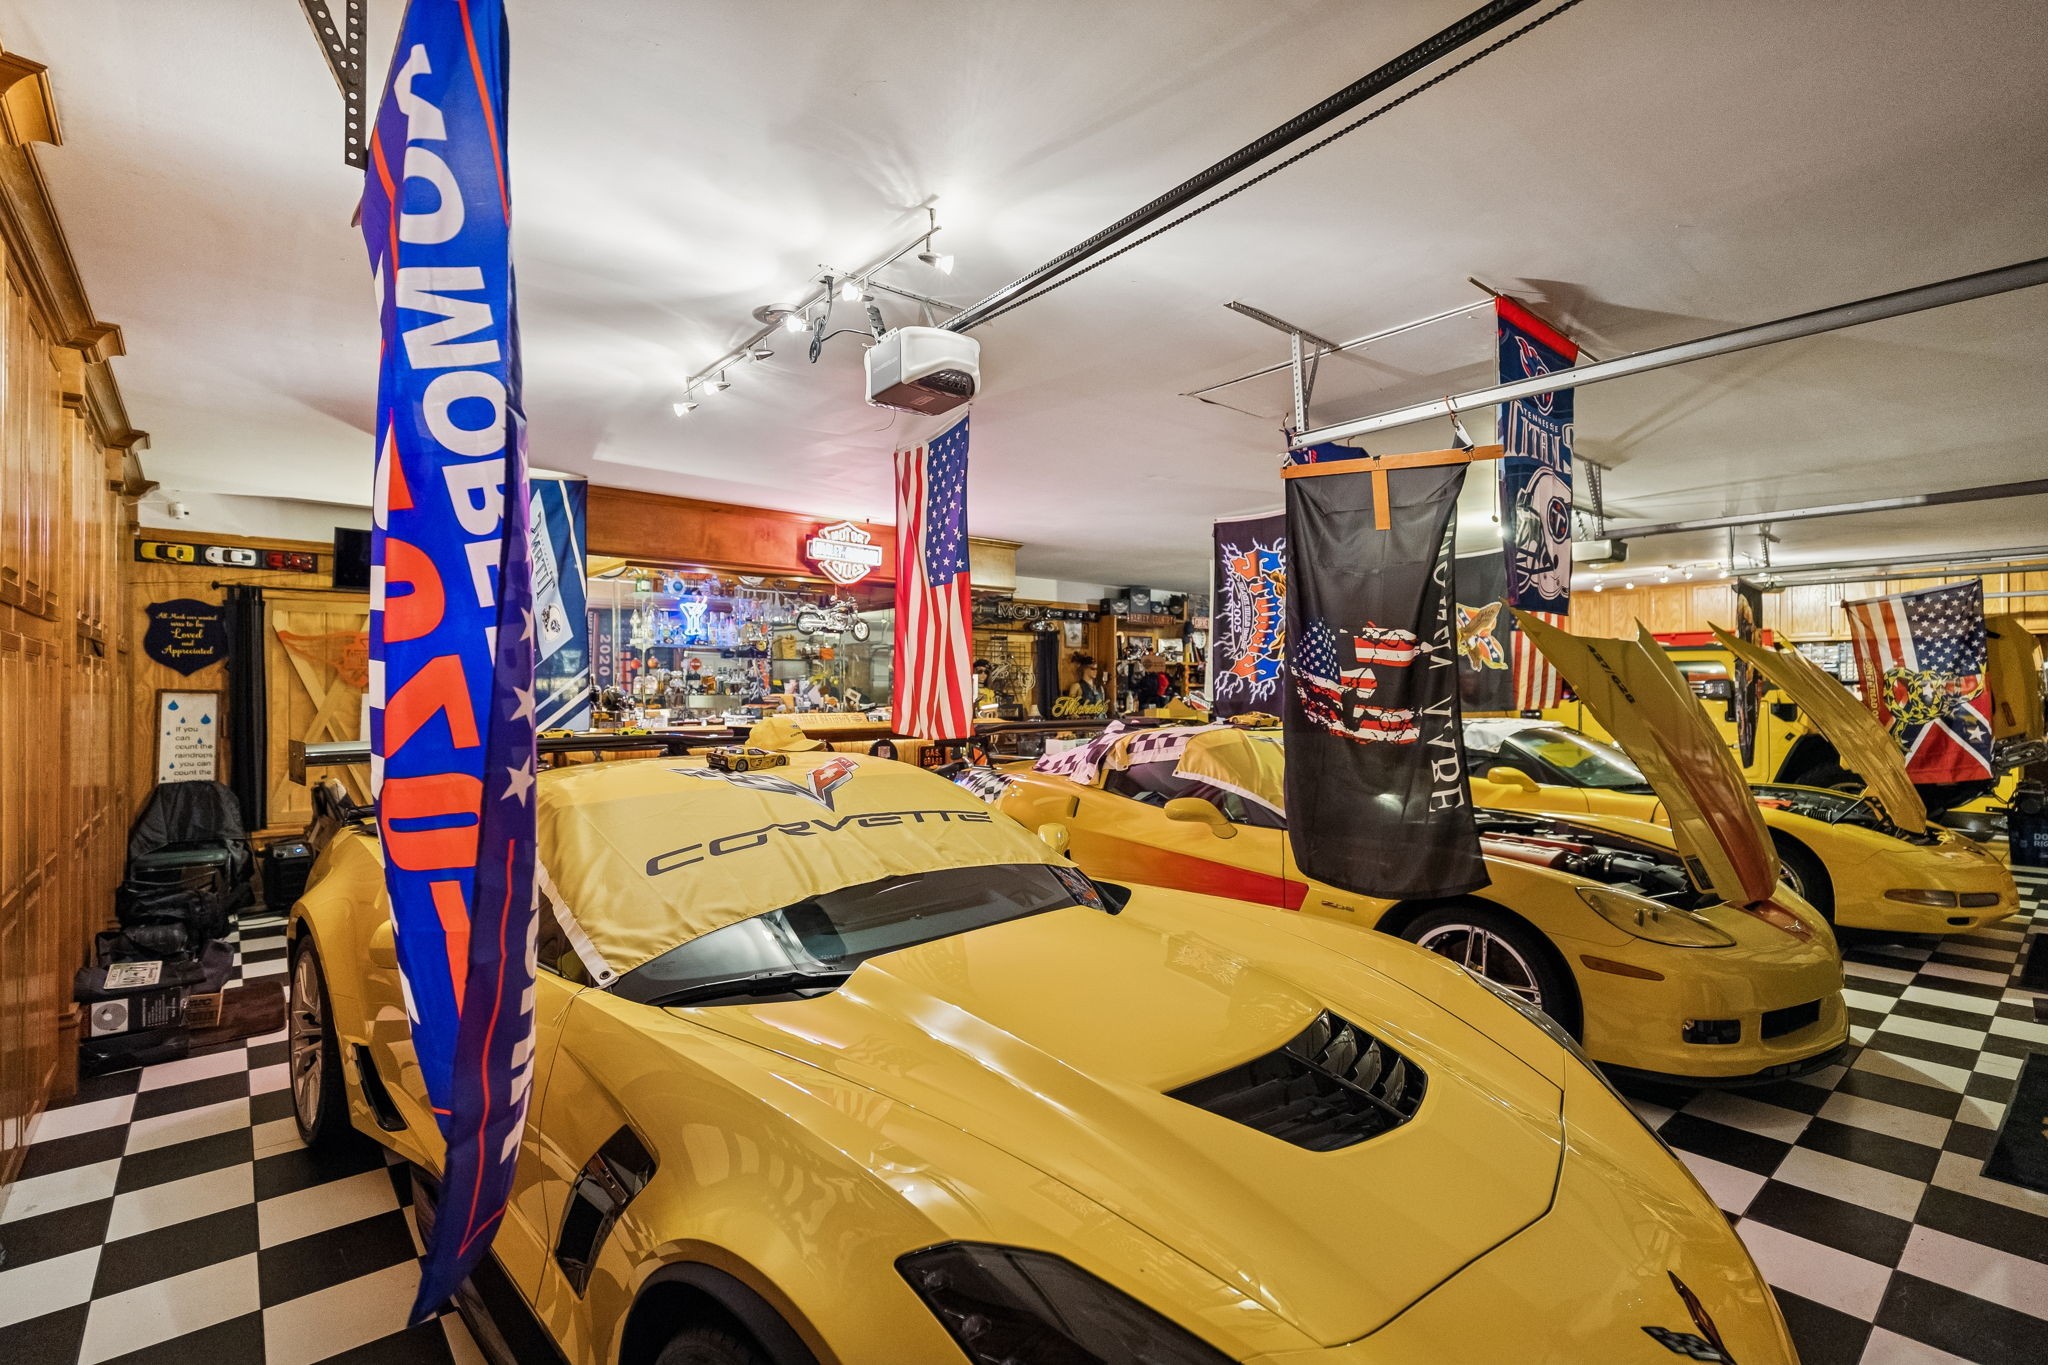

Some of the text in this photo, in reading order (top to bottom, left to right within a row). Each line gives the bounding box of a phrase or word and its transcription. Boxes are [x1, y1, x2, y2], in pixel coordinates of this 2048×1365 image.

[997, 602, 1041, 621] MGD
[1233, 600, 1242, 633] 2005
[171, 628, 204, 639] Loved
[161, 644, 214, 658] Appreciated
[600, 634, 611, 677] 2020
[646, 810, 992, 876] CORVETTE
